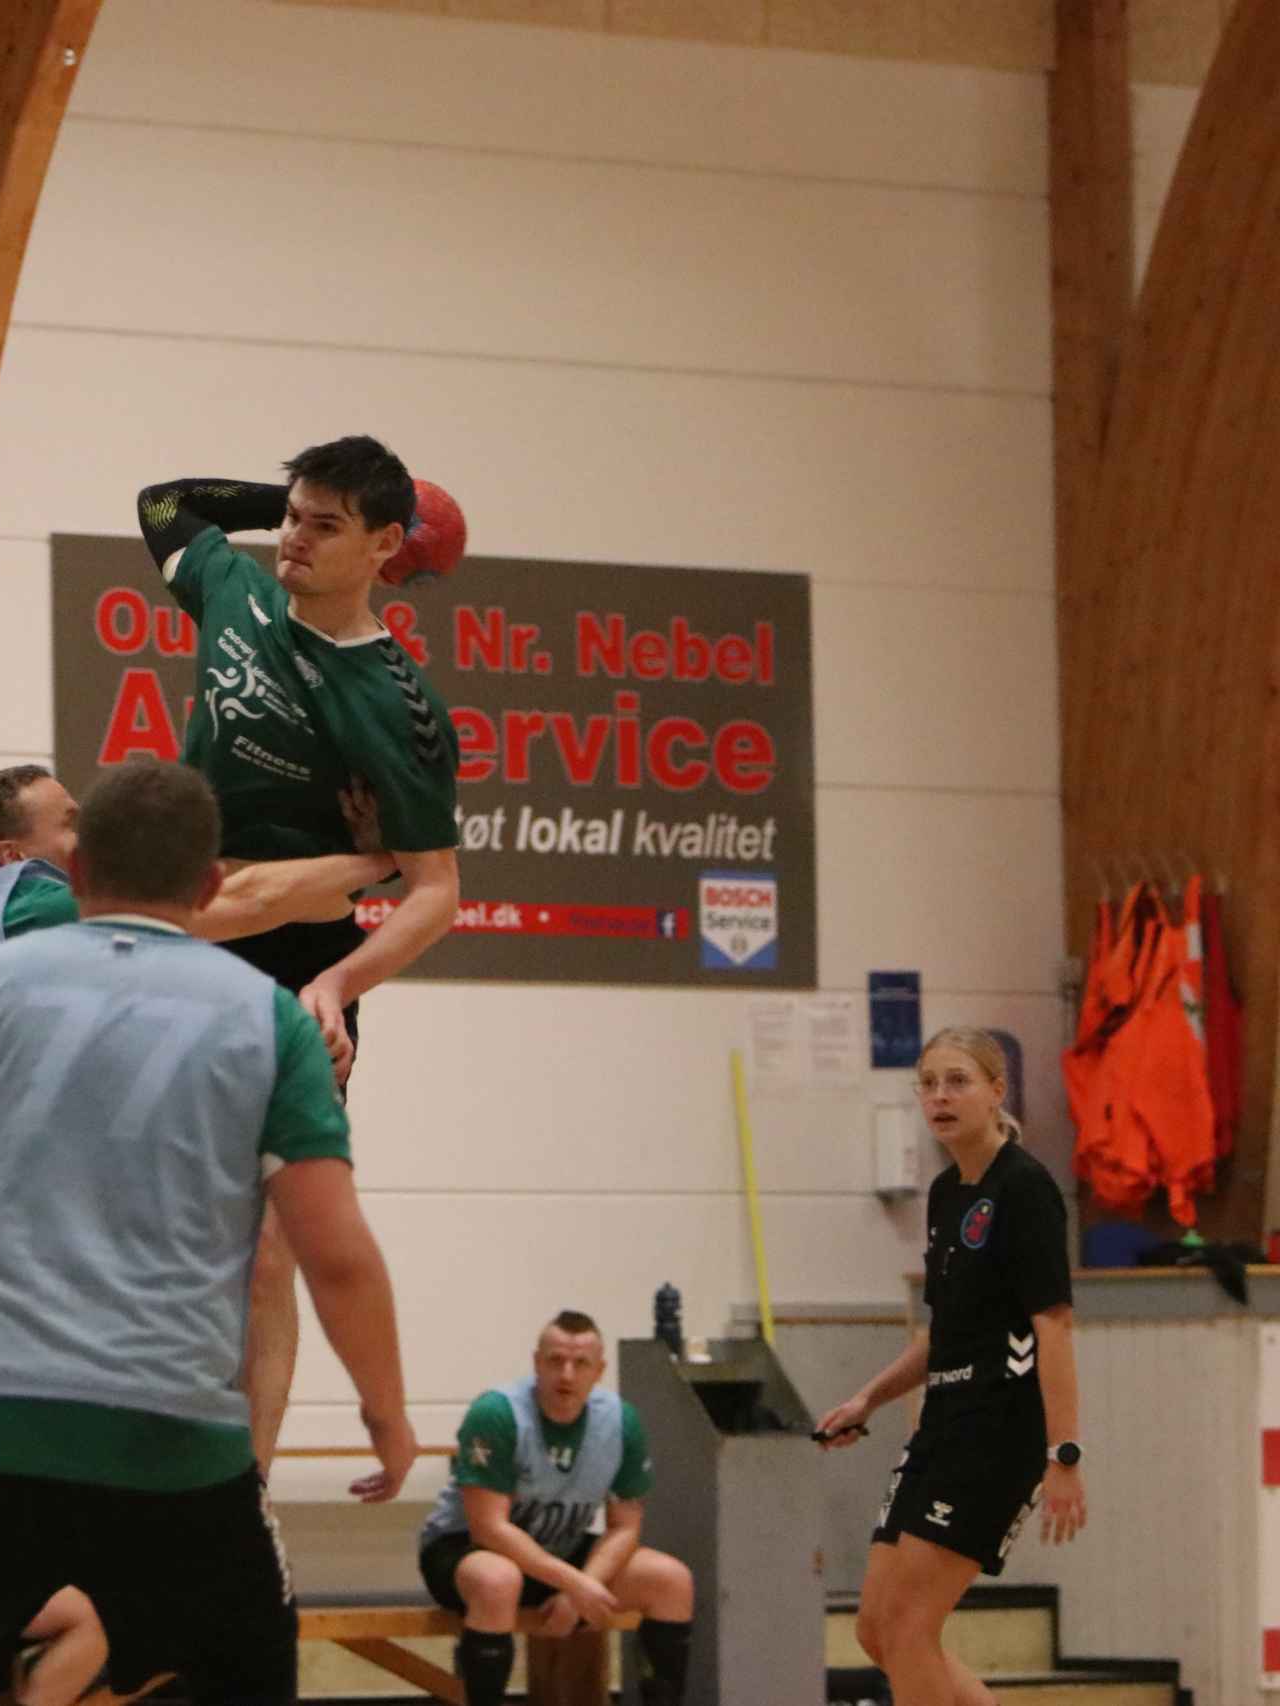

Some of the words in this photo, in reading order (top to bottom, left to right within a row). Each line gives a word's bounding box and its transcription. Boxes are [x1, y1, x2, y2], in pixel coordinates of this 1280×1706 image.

[453, 606, 553, 674] Nr.
[576, 611, 776, 686] Nebel
[447, 691, 777, 794] ervice
[454, 804, 507, 852] tøt
[516, 805, 625, 855] lokal
[632, 810, 777, 862] kvalitet
[706, 886, 773, 908] BOSCH
[706, 911, 771, 929] Service
